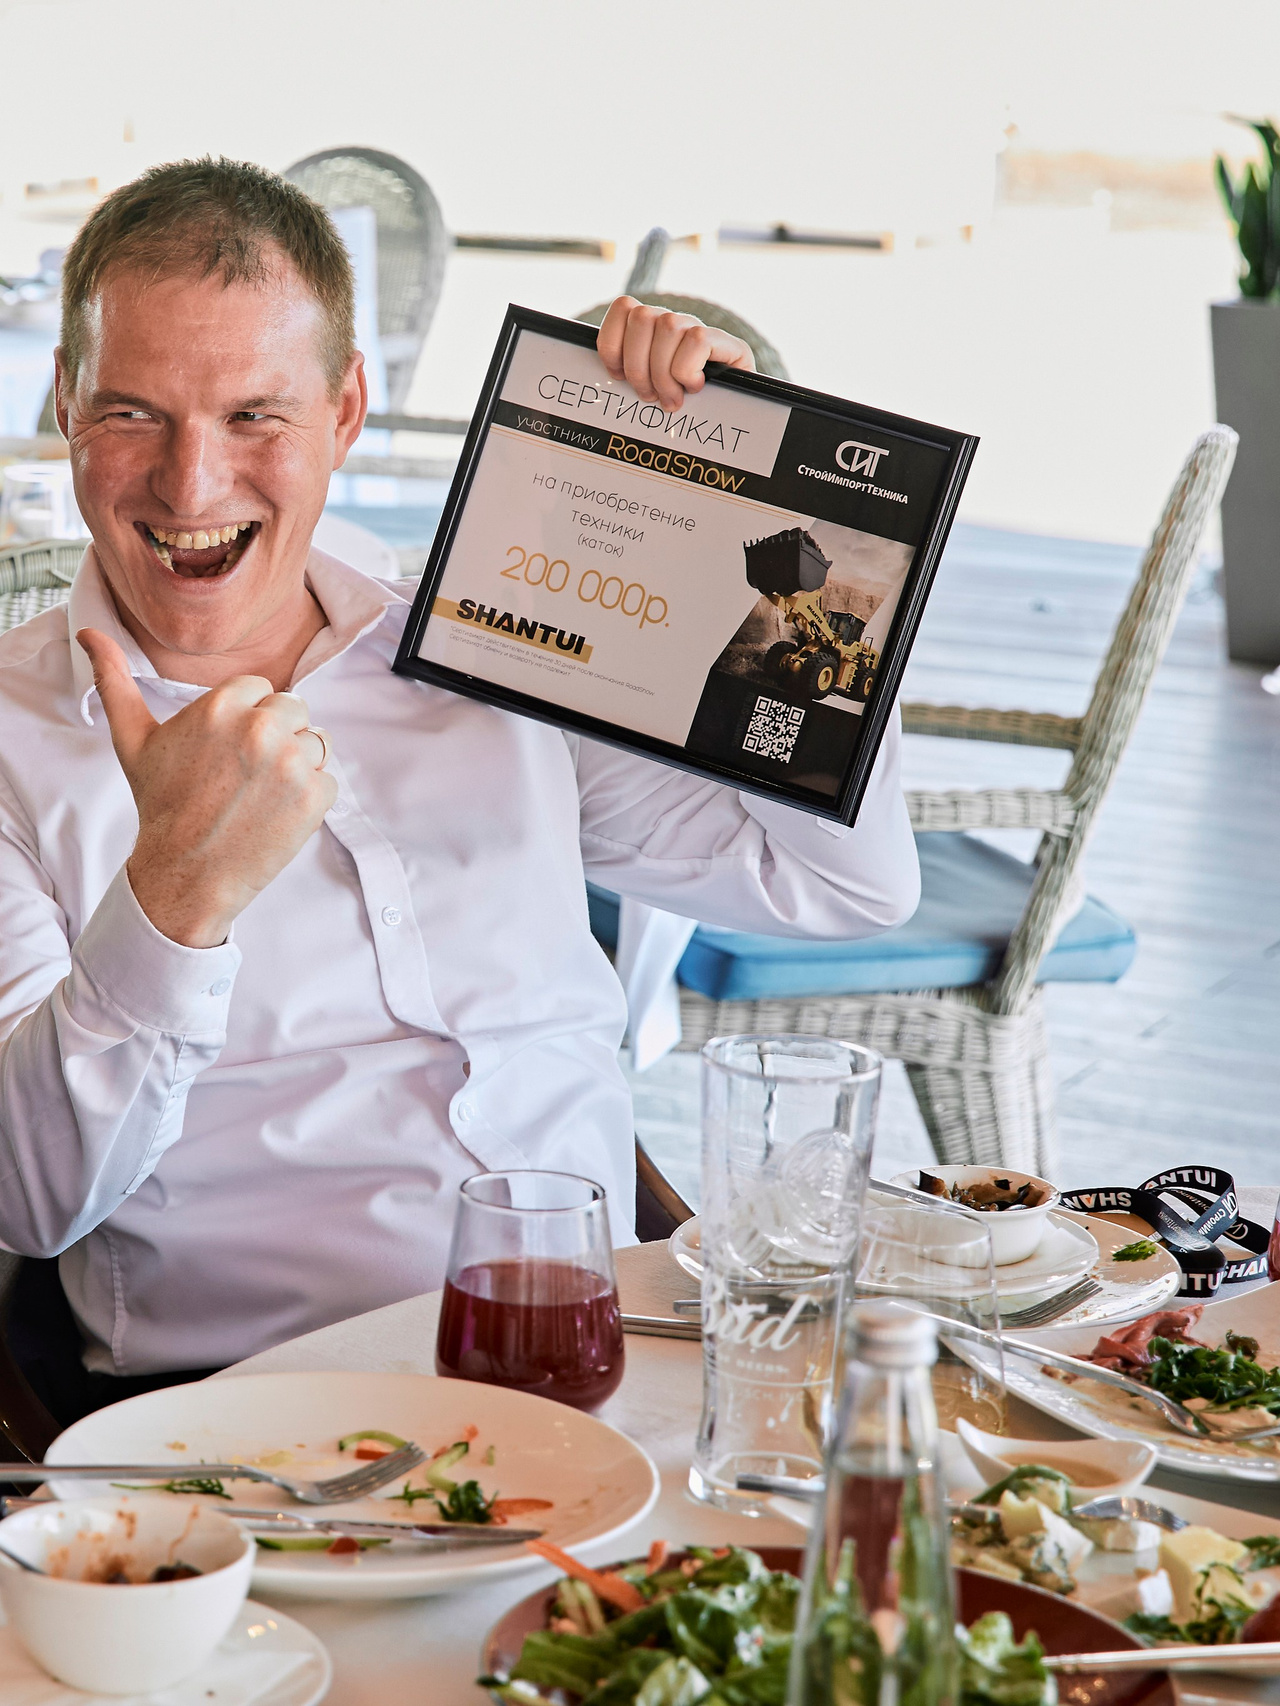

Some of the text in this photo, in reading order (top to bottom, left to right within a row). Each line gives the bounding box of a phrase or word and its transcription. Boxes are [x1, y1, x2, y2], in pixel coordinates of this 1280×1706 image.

[538, 374, 750, 453] СЕРТИФИКАТ
[516, 414, 746, 493] участнику RoadShow
[835, 440, 890, 478] СИТ
[532, 473, 696, 532] на приобретение
[571, 509, 645, 543] техники
[577, 533, 624, 558] (каток)
[500, 546, 570, 592] 200
[457, 599, 586, 655] SHANTUI
[1062, 1191, 1132, 1209] SHAN
